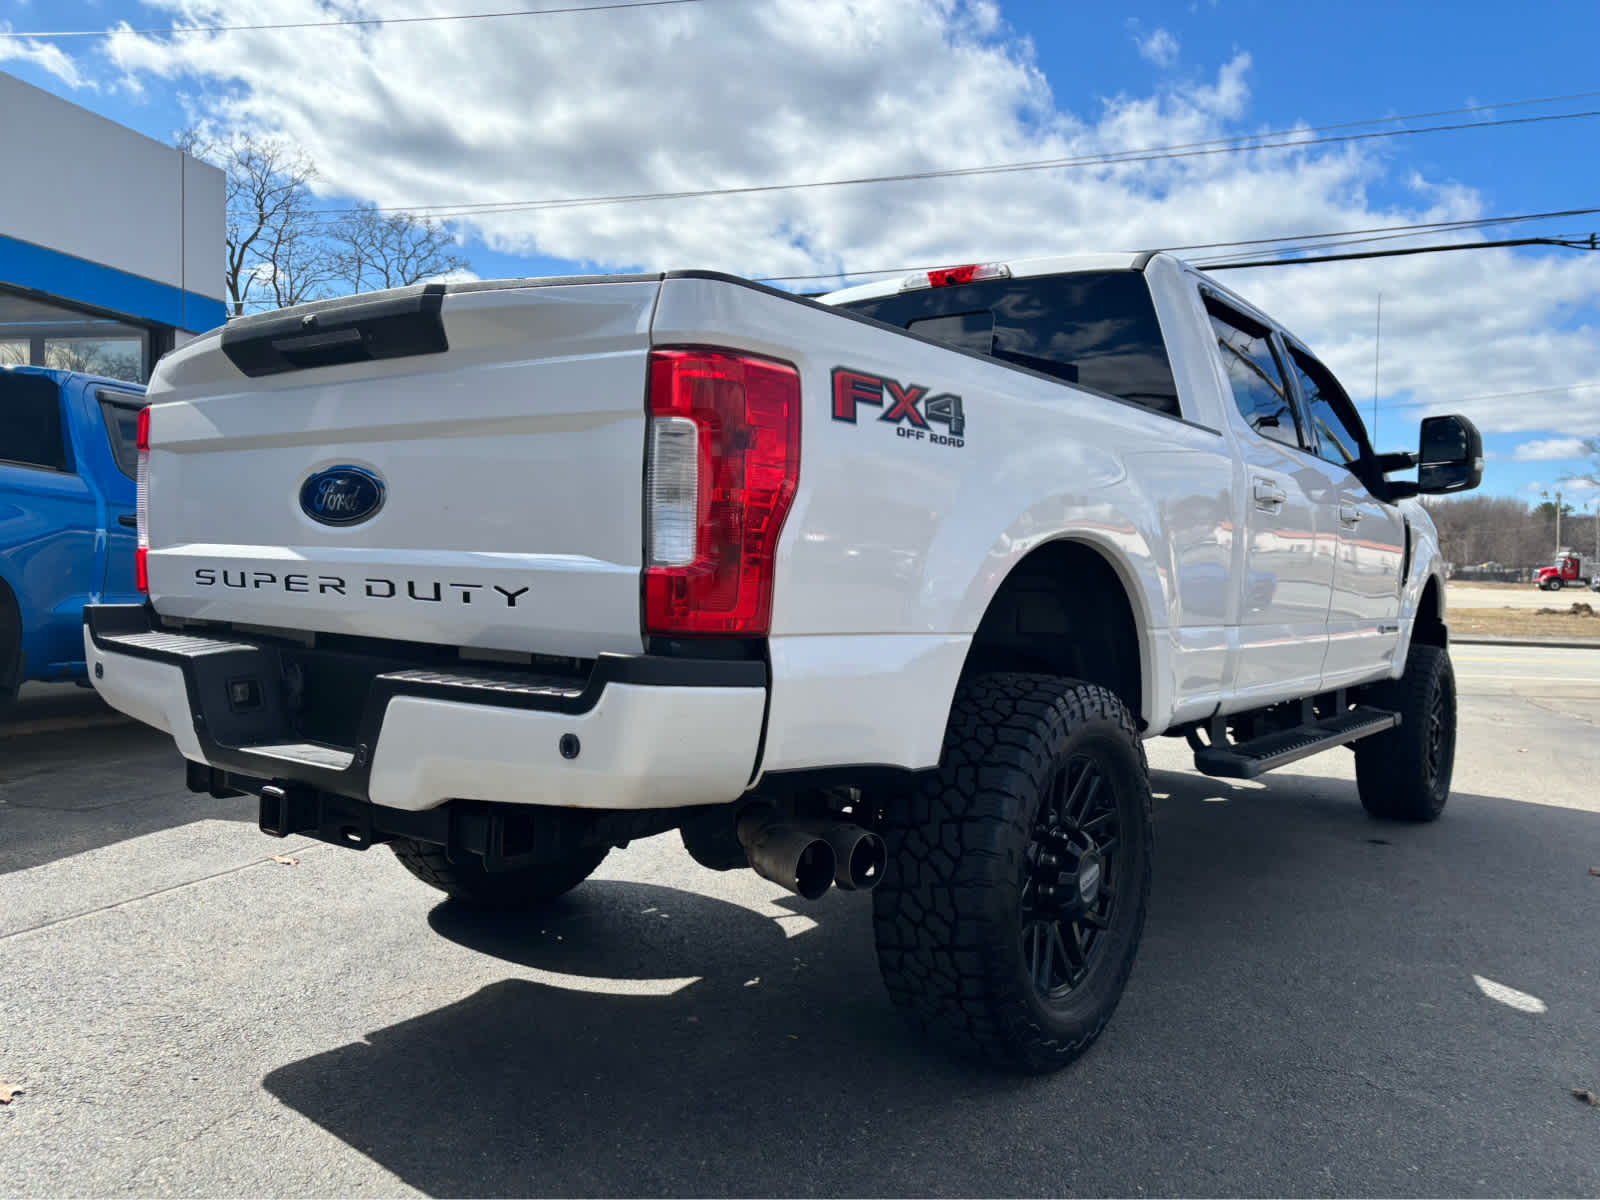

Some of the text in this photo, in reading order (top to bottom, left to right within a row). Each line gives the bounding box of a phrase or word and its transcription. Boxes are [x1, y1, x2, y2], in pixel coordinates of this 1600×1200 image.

[830, 365, 965, 437] FX4
[896, 426, 965, 448] OFF ROAD
[313, 478, 362, 512] Ford
[195, 569, 529, 607] SUPER DUTY
